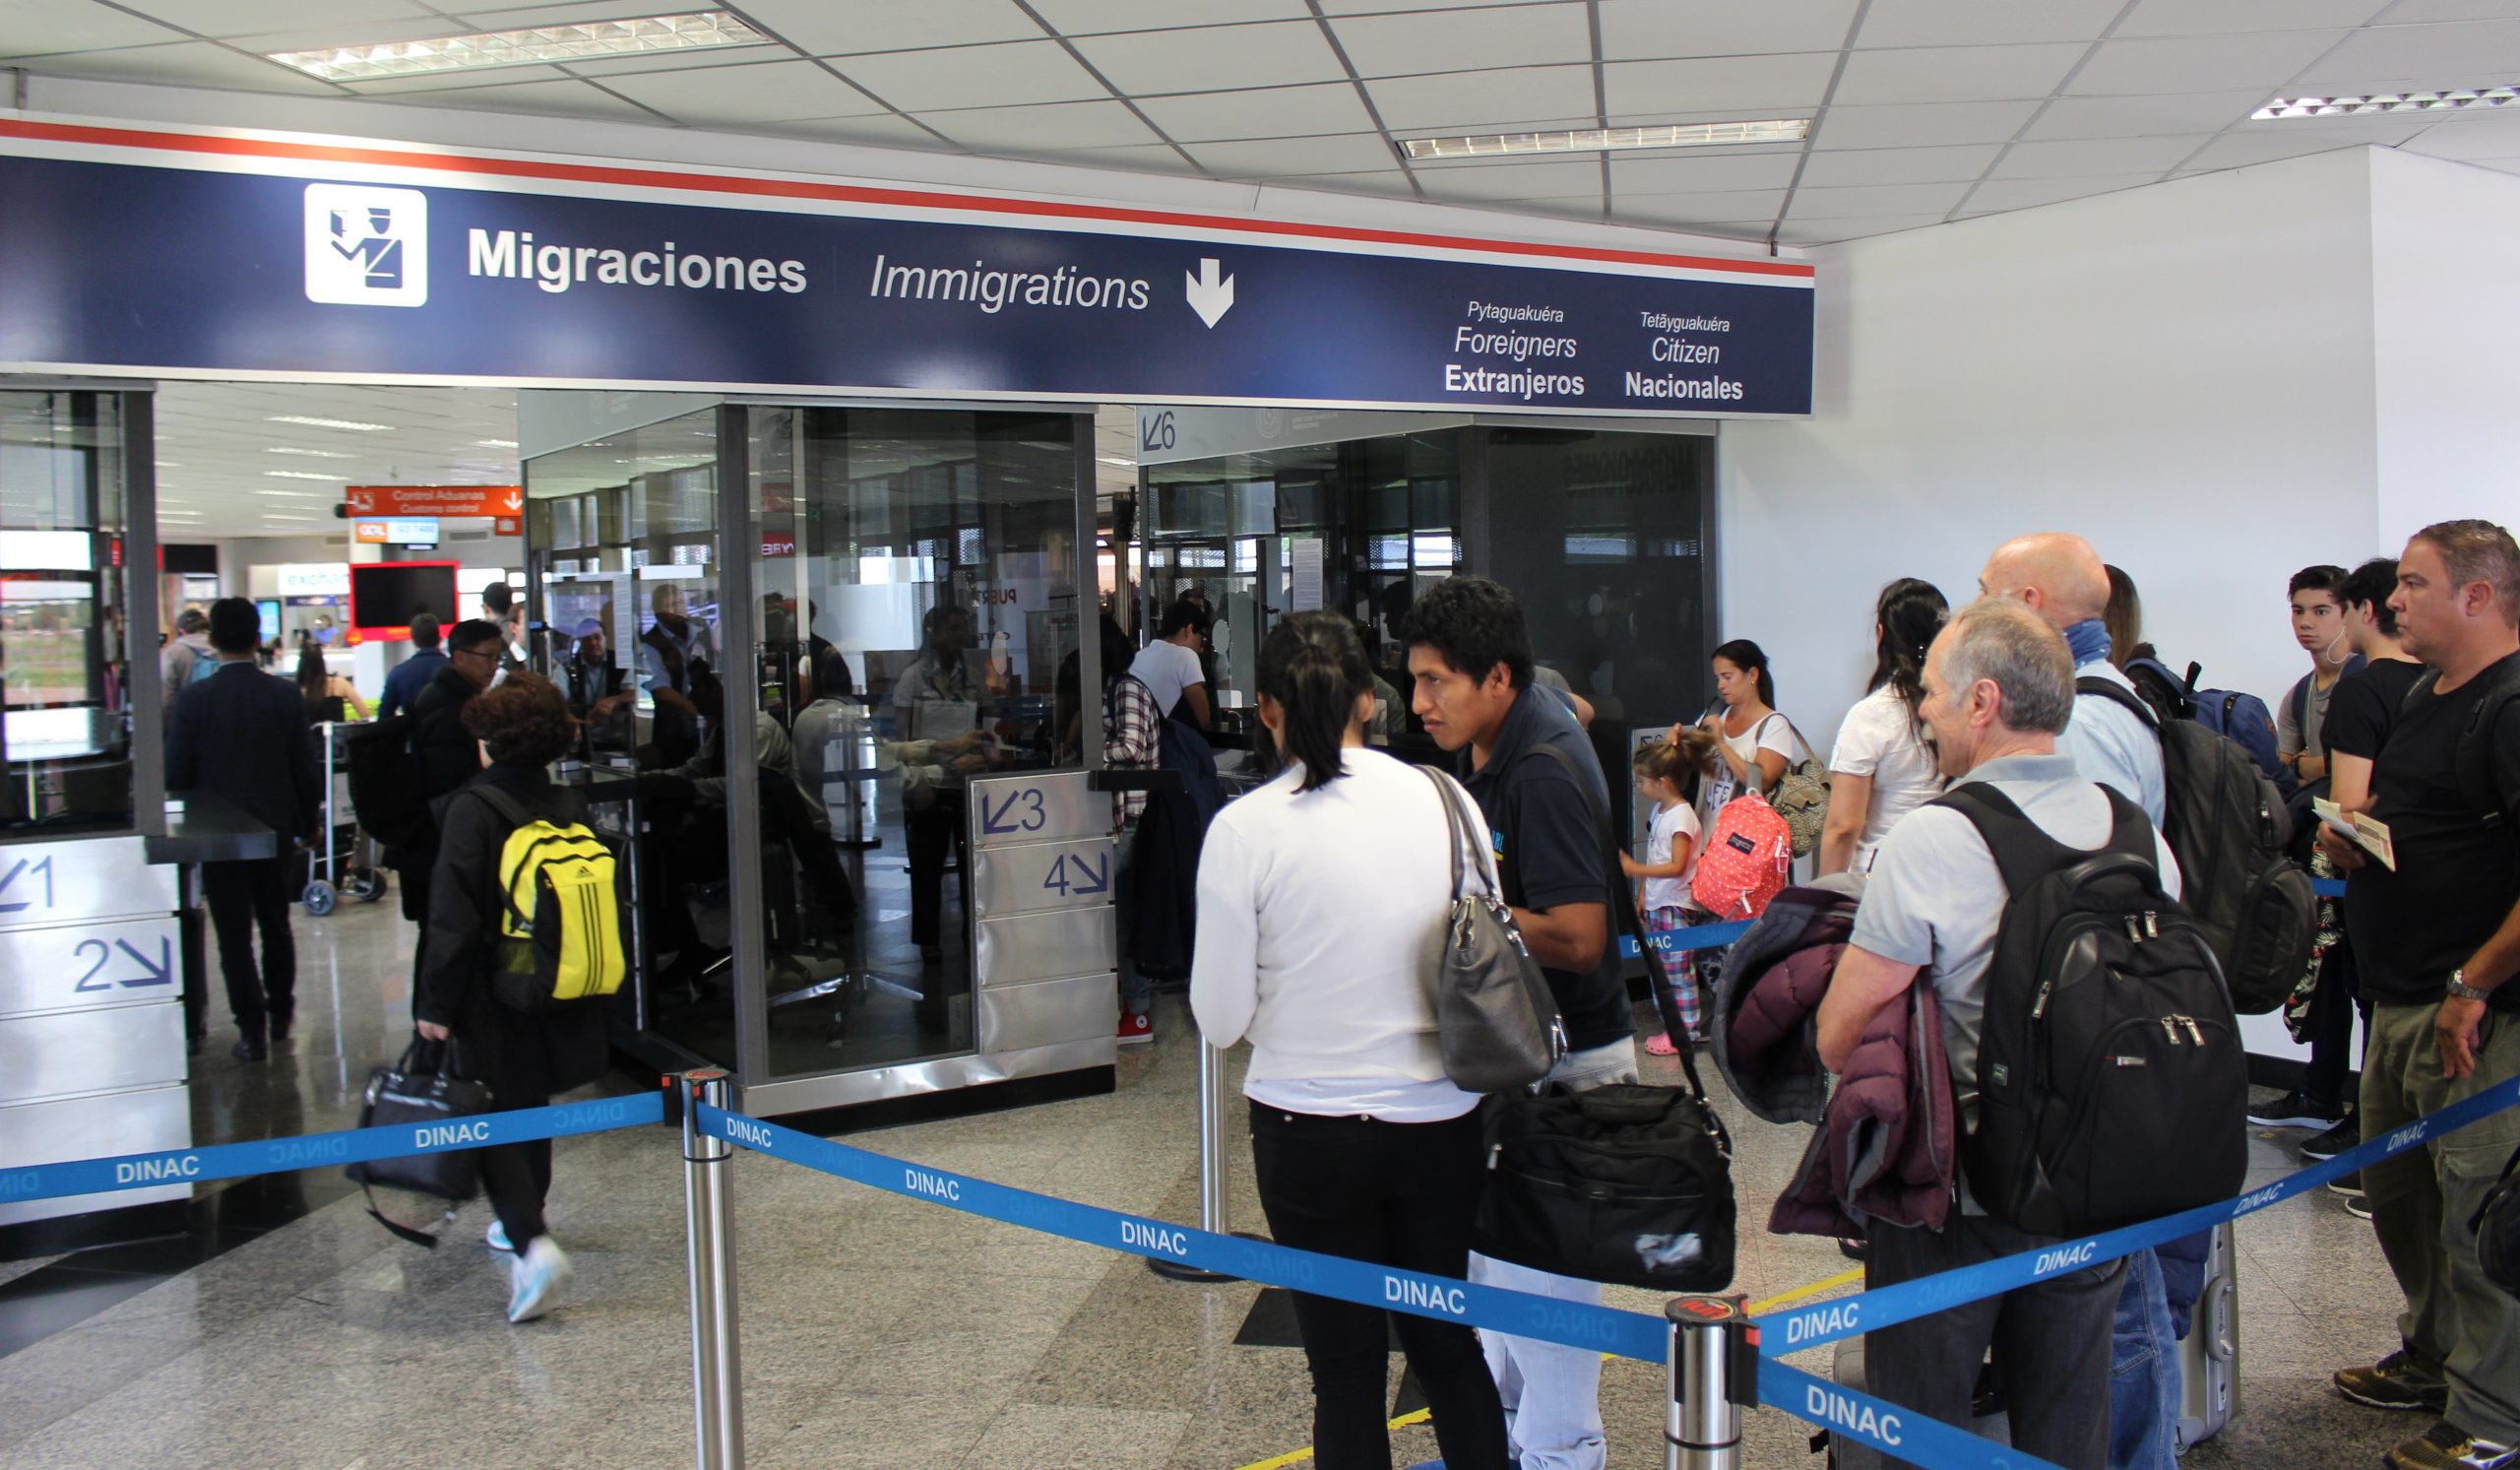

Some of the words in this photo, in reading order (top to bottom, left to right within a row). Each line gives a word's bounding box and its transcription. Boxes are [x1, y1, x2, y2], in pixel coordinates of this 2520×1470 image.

[468, 227, 807, 293] Migraciones
[870, 254, 1150, 314] Immigrations
[1468, 300, 1564, 324] Pytaguakuéra
[1641, 311, 1731, 334] Tetãyguakuéra
[1454, 326, 1577, 362] Foreigners
[1652, 336, 1720, 364] Citizen
[1444, 364, 1585, 400] Extranjeros
[1625, 371, 1743, 401] Nacionales
[1162, 411, 1175, 450] 6
[393, 489, 434, 501] Control
[437, 489, 486, 502] Aduanas
[399, 502, 444, 513] Customs
[446, 503, 479, 513] control
[1021, 788, 1046, 831] 3
[31, 855, 53, 908] 1
[1043, 854, 1070, 897] 4
[1631, 935, 1672, 953] DNAC
[74, 938, 112, 992] 2
[414, 1121, 489, 1148] DINAC
[725, 1117, 773, 1148] DINAC
[2386, 1120, 2427, 1152] DINAC
[116, 1155, 200, 1183] DINAC
[906, 1169, 960, 1201] DINAC
[2233, 1182, 2284, 1216] DINAC
[1121, 1220, 1187, 1256] DINAC
[2034, 1241, 2097, 1276] DINAC
[1385, 1275, 1466, 1314] DINAC
[1787, 1303, 1859, 1344] DINAC
[1807, 1384, 1902, 1446] DINAC
